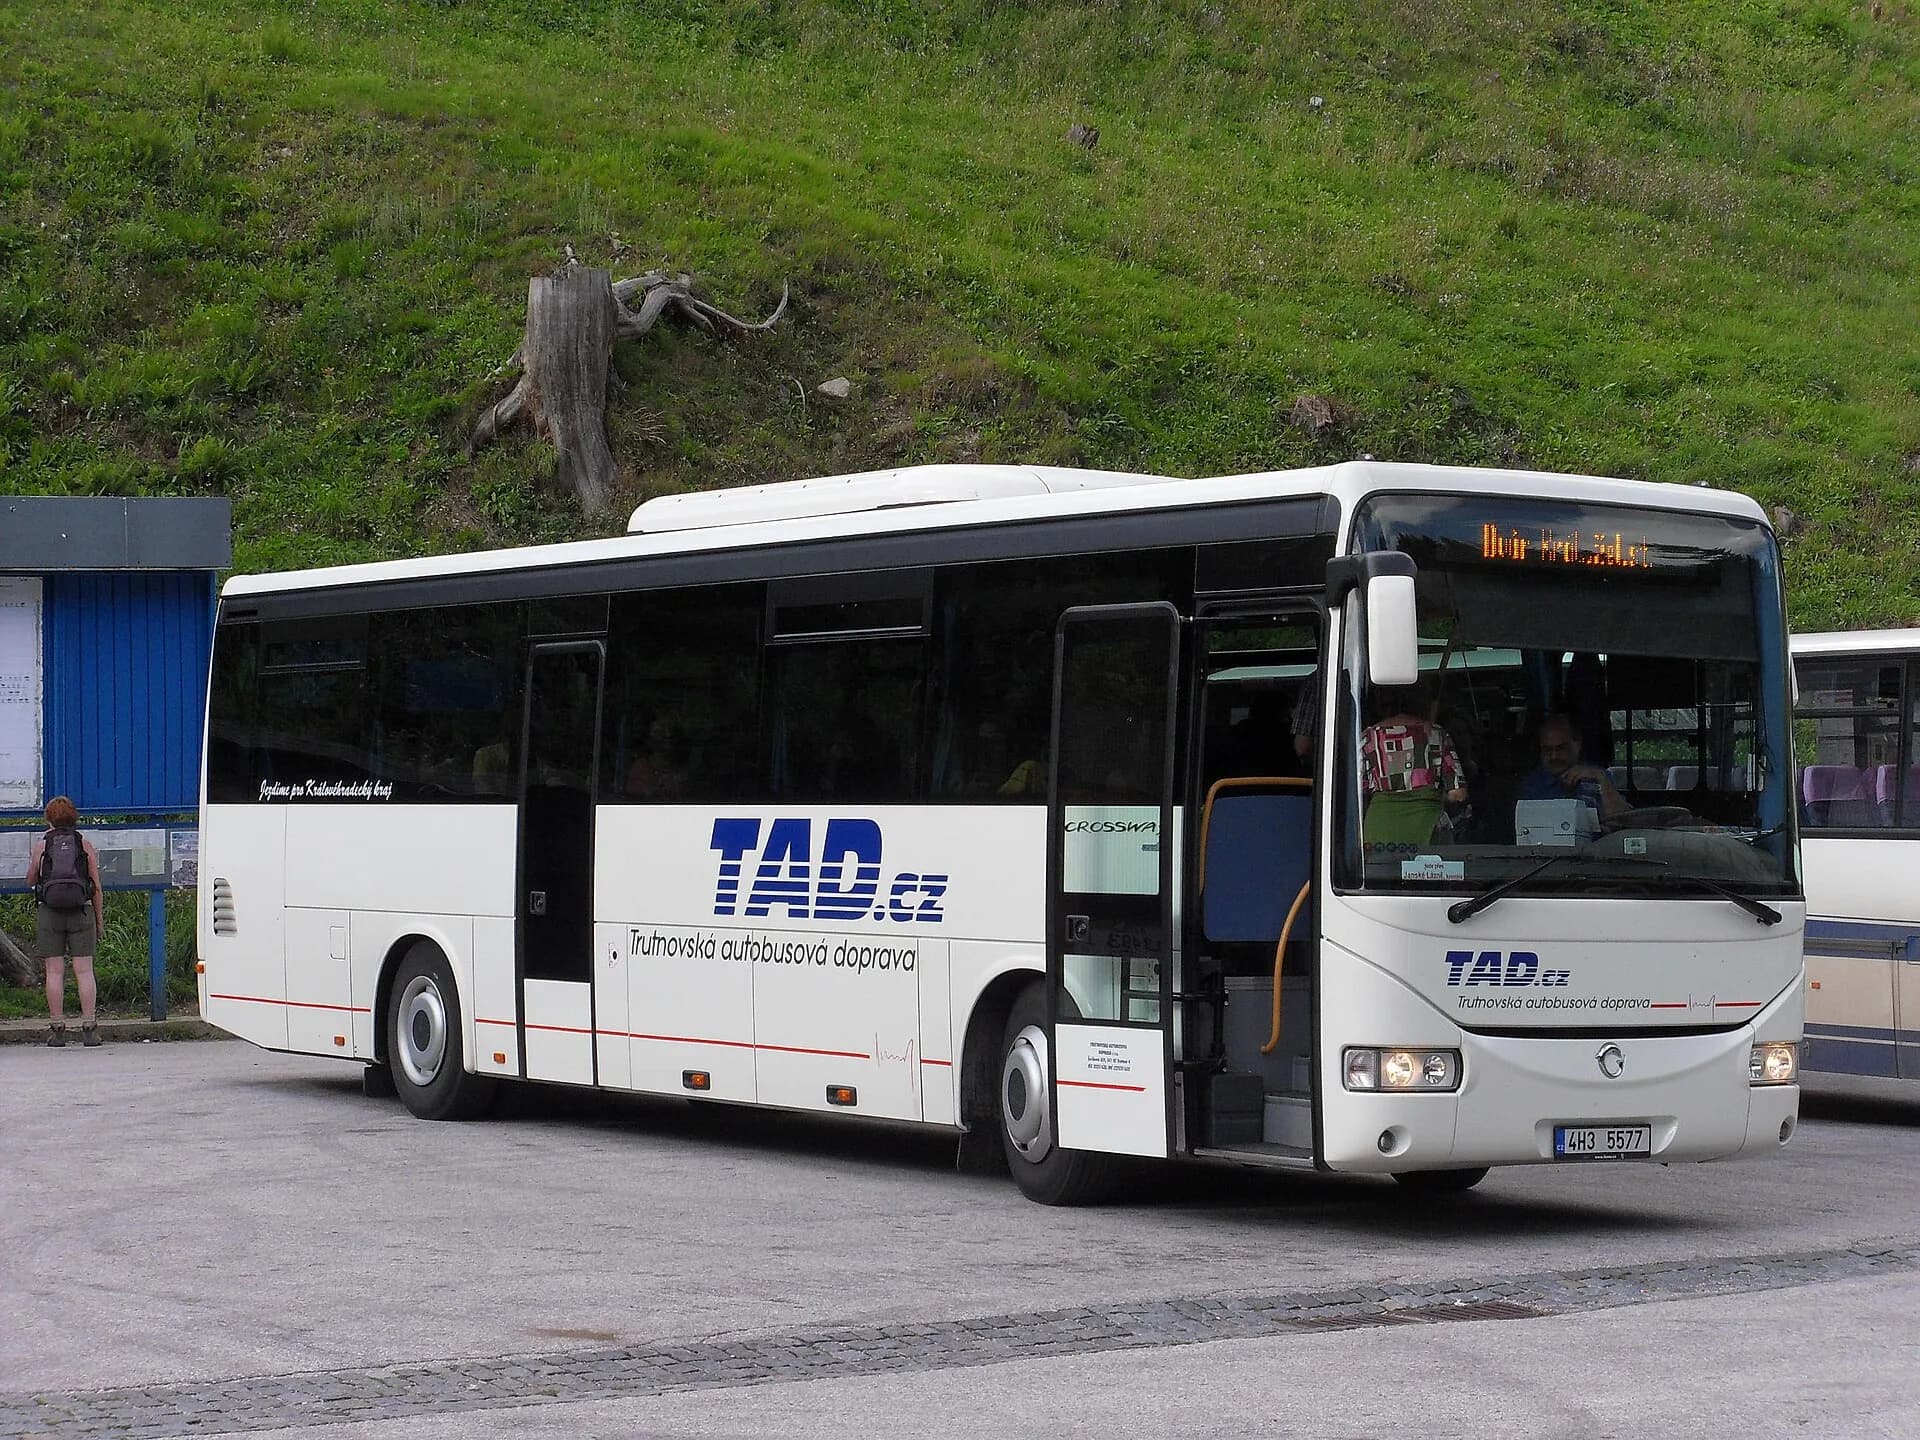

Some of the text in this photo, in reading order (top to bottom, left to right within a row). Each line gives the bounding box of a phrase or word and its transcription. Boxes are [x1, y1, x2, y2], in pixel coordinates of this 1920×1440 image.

[258, 778, 393, 801] Jezdíme pro Královéhradecký kraj
[1065, 820, 1160, 836] CROSSWA
[709, 817, 949, 923] TAD.cz
[630, 928, 916, 975] Trutnovská autobusová doprava
[1444, 950, 1571, 987] TAD.cz
[1457, 994, 1651, 1012] Trutnovská autobusová doprava
[1568, 1131, 1596, 1151] 4H3
[1606, 1130, 1643, 1150] 5577
